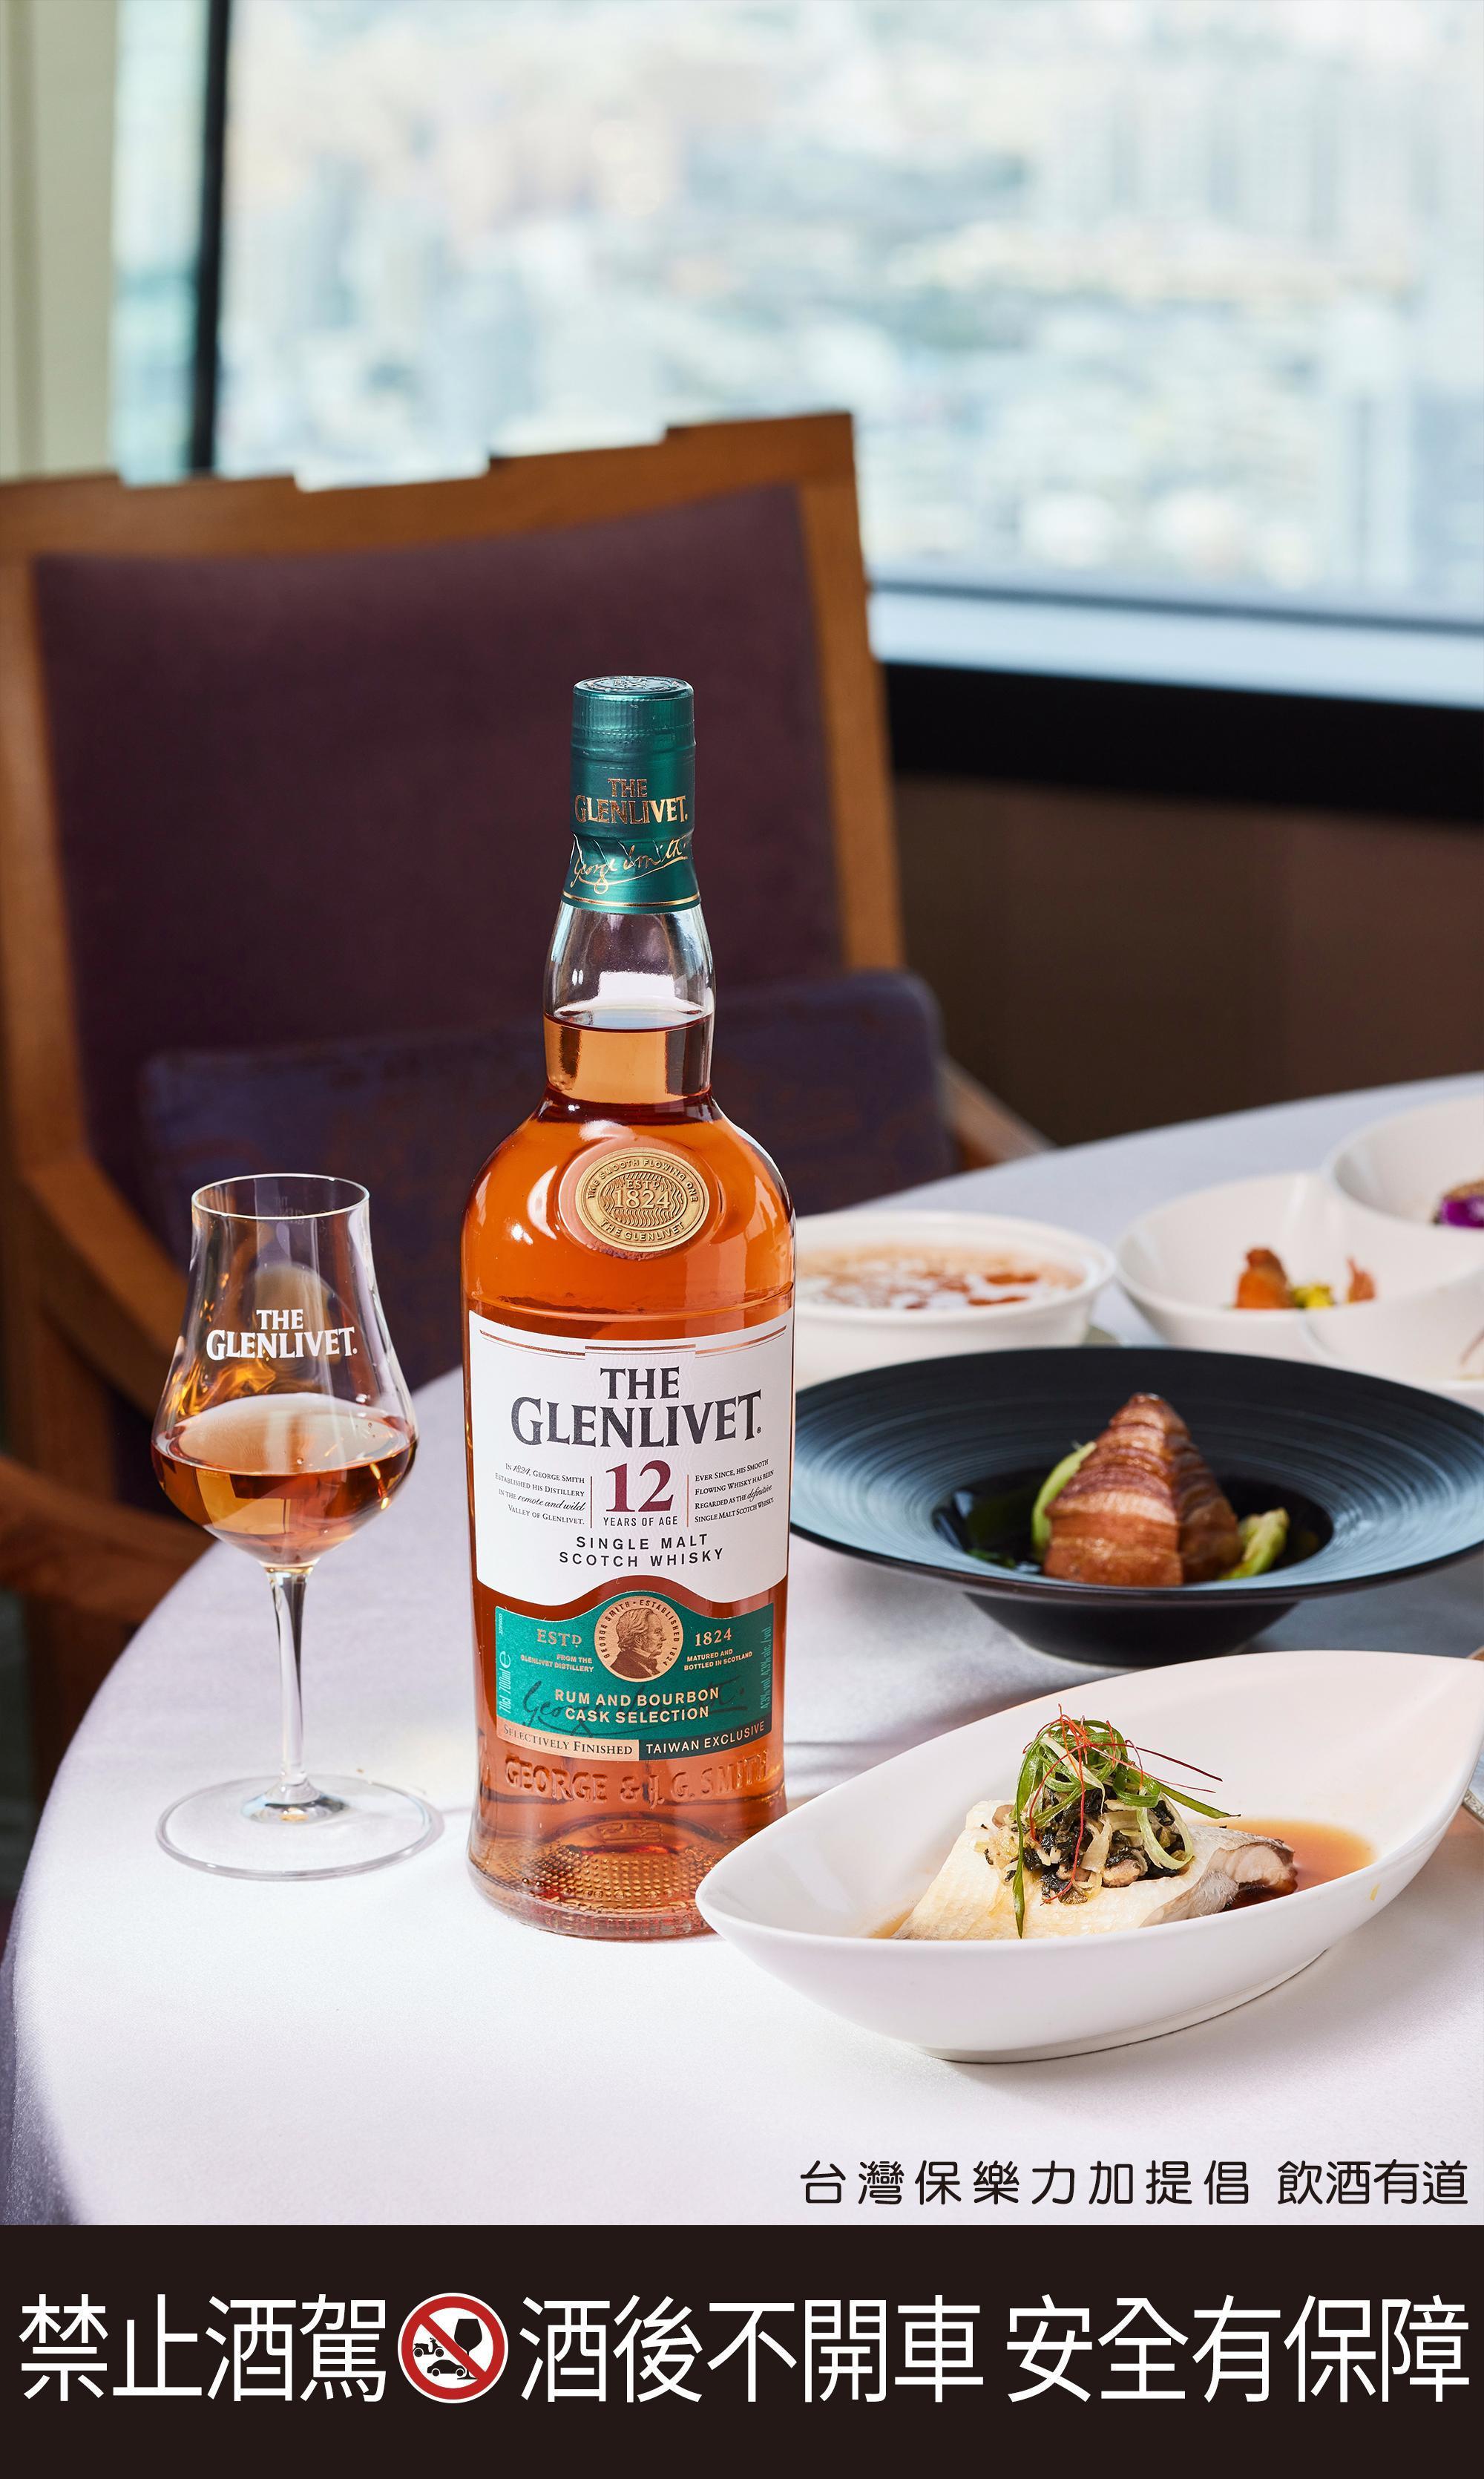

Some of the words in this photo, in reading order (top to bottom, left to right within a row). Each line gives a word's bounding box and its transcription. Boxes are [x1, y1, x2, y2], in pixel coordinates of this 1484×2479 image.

[608, 778, 648, 798] THE
[587, 1180, 600, 1199] THE
[599, 1159, 640, 1179] SMOOTH
[643, 1159, 686, 1182] FLOWING
[686, 1182, 698, 1202] ONE
[614, 1188, 671, 1210] 1824
[601, 1219, 621, 1237] THE
[624, 1221, 685, 1242] GLENLIVET
[256, 1309, 303, 1330] THE
[600, 1366, 680, 1400] THE
[605, 1460, 674, 1513] 12
[603, 1517, 637, 1527] YEARS
[642, 1517, 654, 1527] OF
[658, 1516, 677, 1526] AGE
[576, 1536, 649, 1550] SINGLE
[661, 1533, 707, 1549] MALT
[559, 1551, 637, 1568] SCOTCH
[650, 1548, 723, 1567] WHISKY
[599, 1624, 610, 1659] GEORGE
[605, 1601, 630, 1622] SMITH
[640, 1599, 680, 1642] ESTABLISHED
[663, 1647, 677, 1666] 1824
[695, 1627, 732, 1647] 1824
[521, 1654, 553, 1668] GLENLIVET
[554, 1662, 594, 1673] DISTILLERY
[556, 1654, 577, 1662] FROM
[683, 1661, 713, 1671] BOTTLED
[723, 1651, 752, 1664] SCOTLAND
[686, 1652, 718, 1662] MATURED
[720, 1648, 733, 1657] AND
[555, 1689, 590, 1705] RUM
[596, 1695, 631, 1706] AND
[637, 1686, 719, 1706] BOURBON
[565, 1708, 610, 1723] CASK
[615, 1706, 709, 1724] SELECTION
[646, 1740, 700, 1754] TAIWAN
[704, 1721, 765, 1749] EXCLUSIVE
[505, 1755, 607, 1803] GEORGE
[620, 1776, 642, 1803] &
[700, 1750, 767, 1795] SMITH
